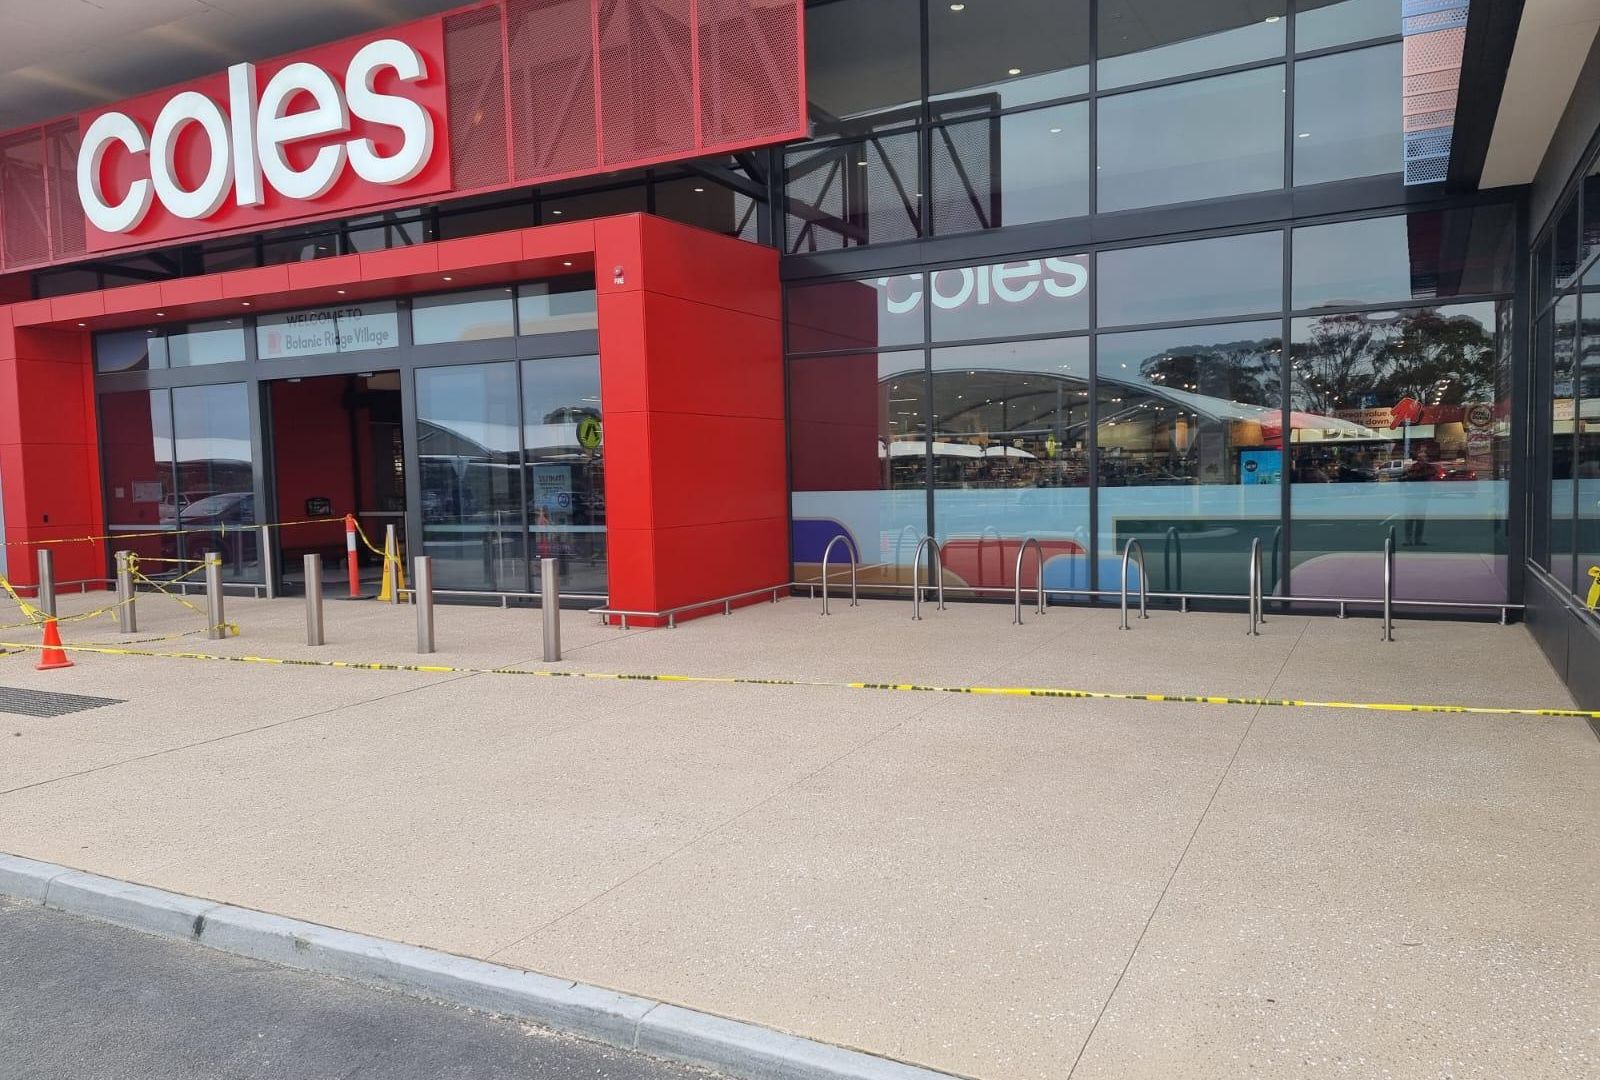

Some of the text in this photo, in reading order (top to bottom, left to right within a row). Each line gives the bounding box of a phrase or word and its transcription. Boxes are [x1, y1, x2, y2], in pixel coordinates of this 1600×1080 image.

[77, 38, 434, 233] coles
[286, 308, 362, 328] WELCOME TO
[285, 334, 322, 350] Botanic
[354, 327, 389, 345] Village
